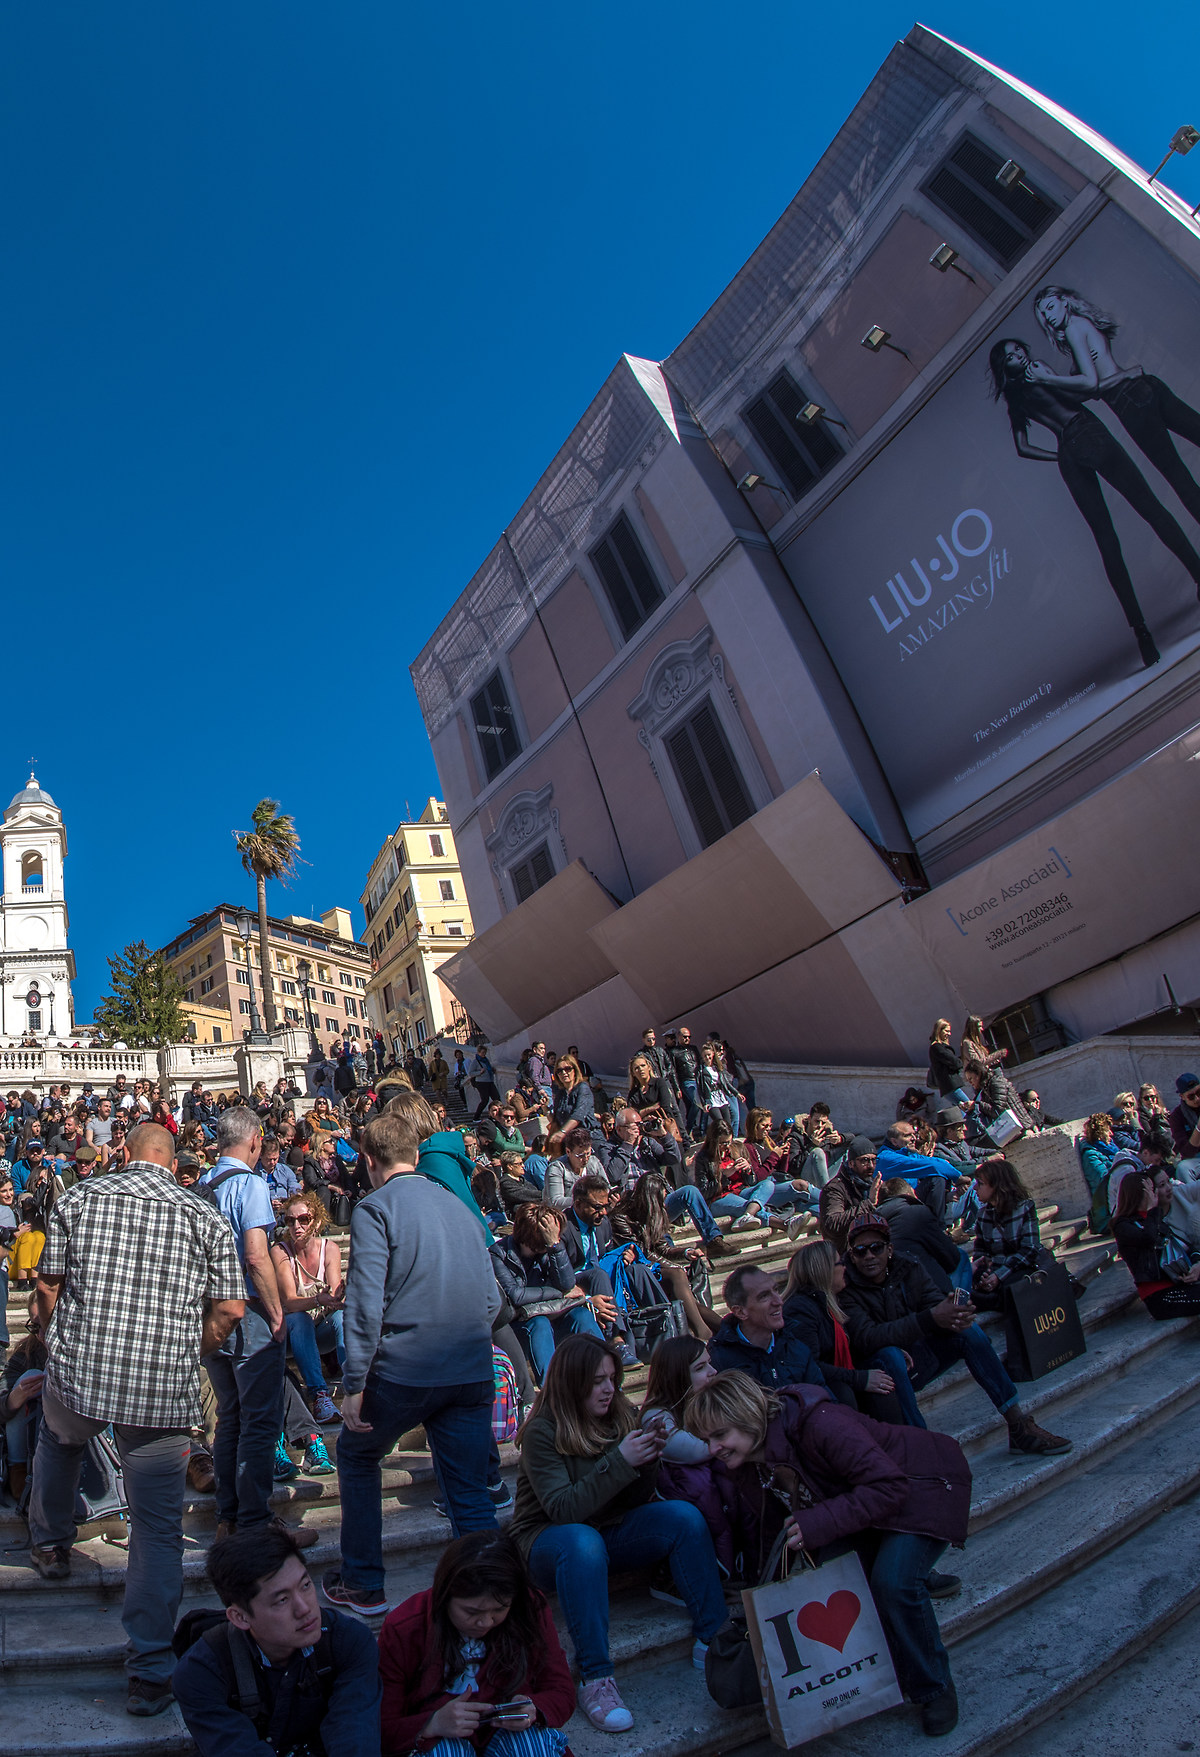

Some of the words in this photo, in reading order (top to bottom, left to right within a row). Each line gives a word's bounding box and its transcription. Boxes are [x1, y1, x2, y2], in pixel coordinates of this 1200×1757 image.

[954, 767, 976, 785] Martha
[976, 755, 992, 769] Hunt
[1045, 707, 1061, 722] Shop
[1061, 702, 1069, 711] at
[1068, 682, 1096, 705] liujo.com
[973, 728, 990, 743] The
[990, 714, 1009, 732] New
[1008, 694, 1039, 718] Bottom
[1038, 683, 1052, 696] Up
[984, 928, 1003, 943] +39
[1003, 920, 1019, 934] 02
[1017, 892, 1068, 926] 72008346
[989, 901, 1074, 951] www.aconeassociati.it
[764, 1609, 812, 1679] I
[787, 1652, 878, 1700] ALCOTT
[822, 1696, 839, 1709] SHOP
[839, 1686, 861, 1702] ONLINE
